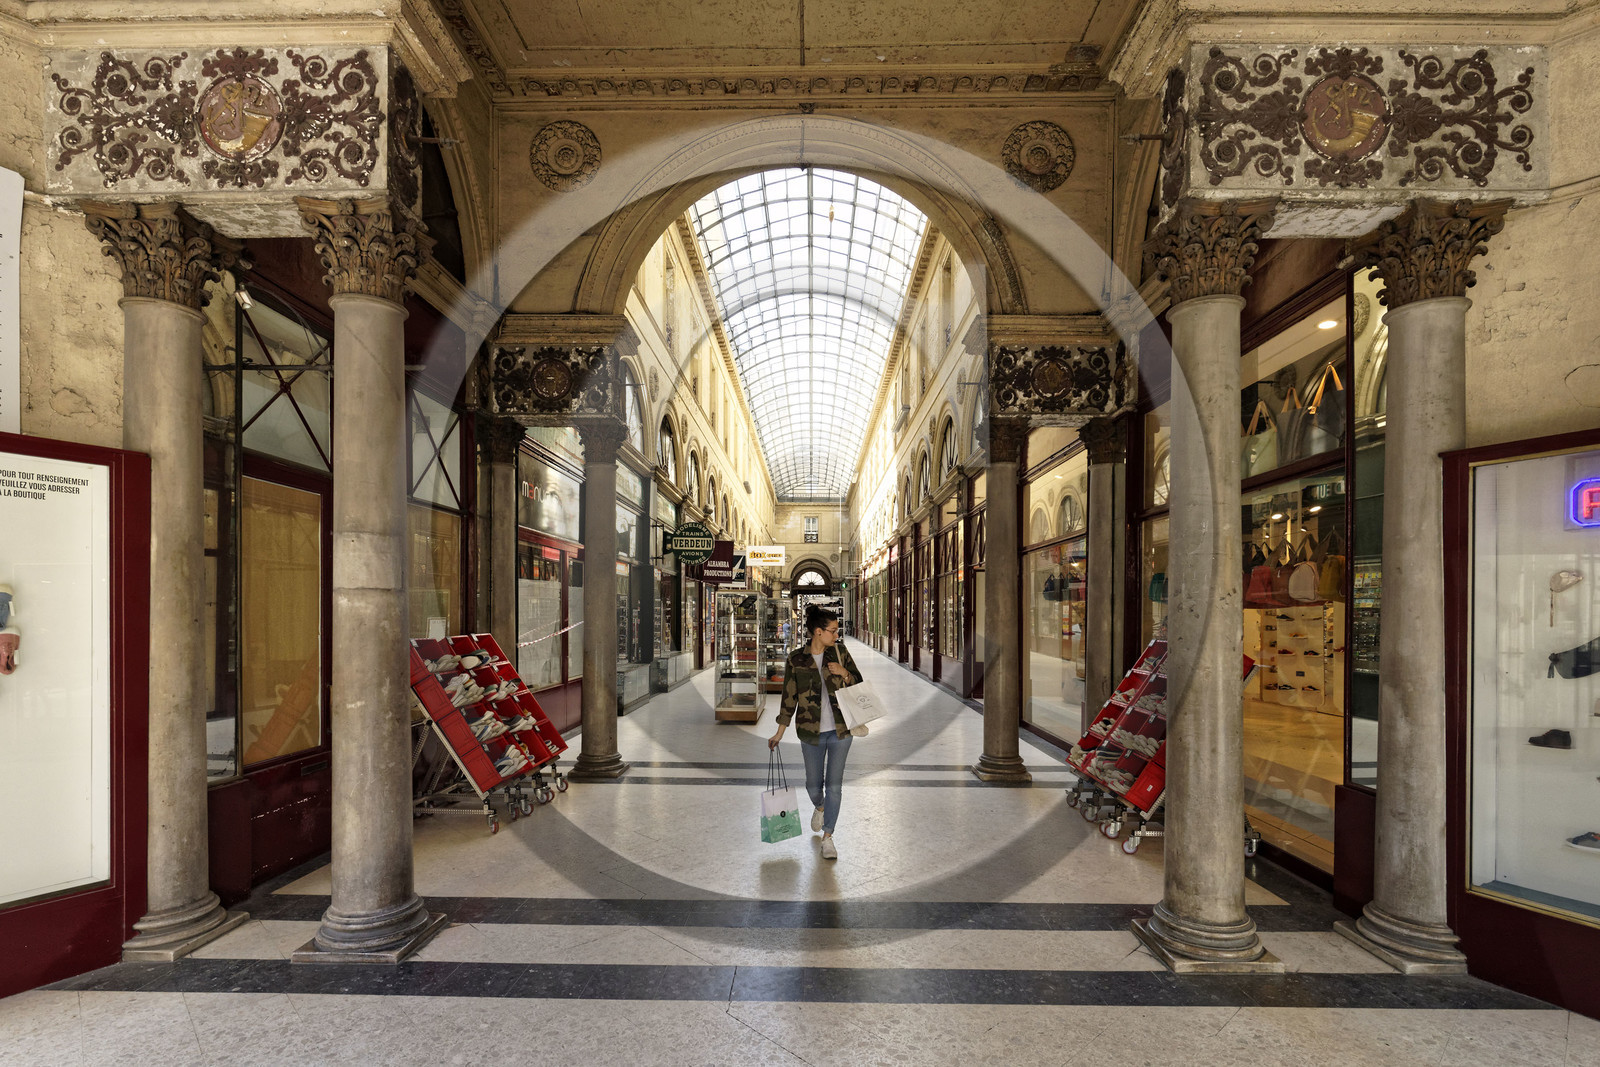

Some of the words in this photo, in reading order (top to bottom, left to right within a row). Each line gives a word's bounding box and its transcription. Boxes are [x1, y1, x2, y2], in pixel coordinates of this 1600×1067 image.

[18, 471, 35, 480] TOUT
[36, 473, 89, 486] RENSEIGNEMENT
[29, 482, 46, 491] VOUS
[48, 484, 80, 495] ADRESSER
[3, 489, 12, 497] LA
[13, 490, 46, 500] BOUTIQUE
[675, 523, 710, 536] MODELISME
[673, 538, 711, 548] VERDEUN
[678, 555, 707, 565] VOITURES
[706, 560, 730, 568] ALHAMBRA
[703, 569, 732, 578] PRODUCTIONS
